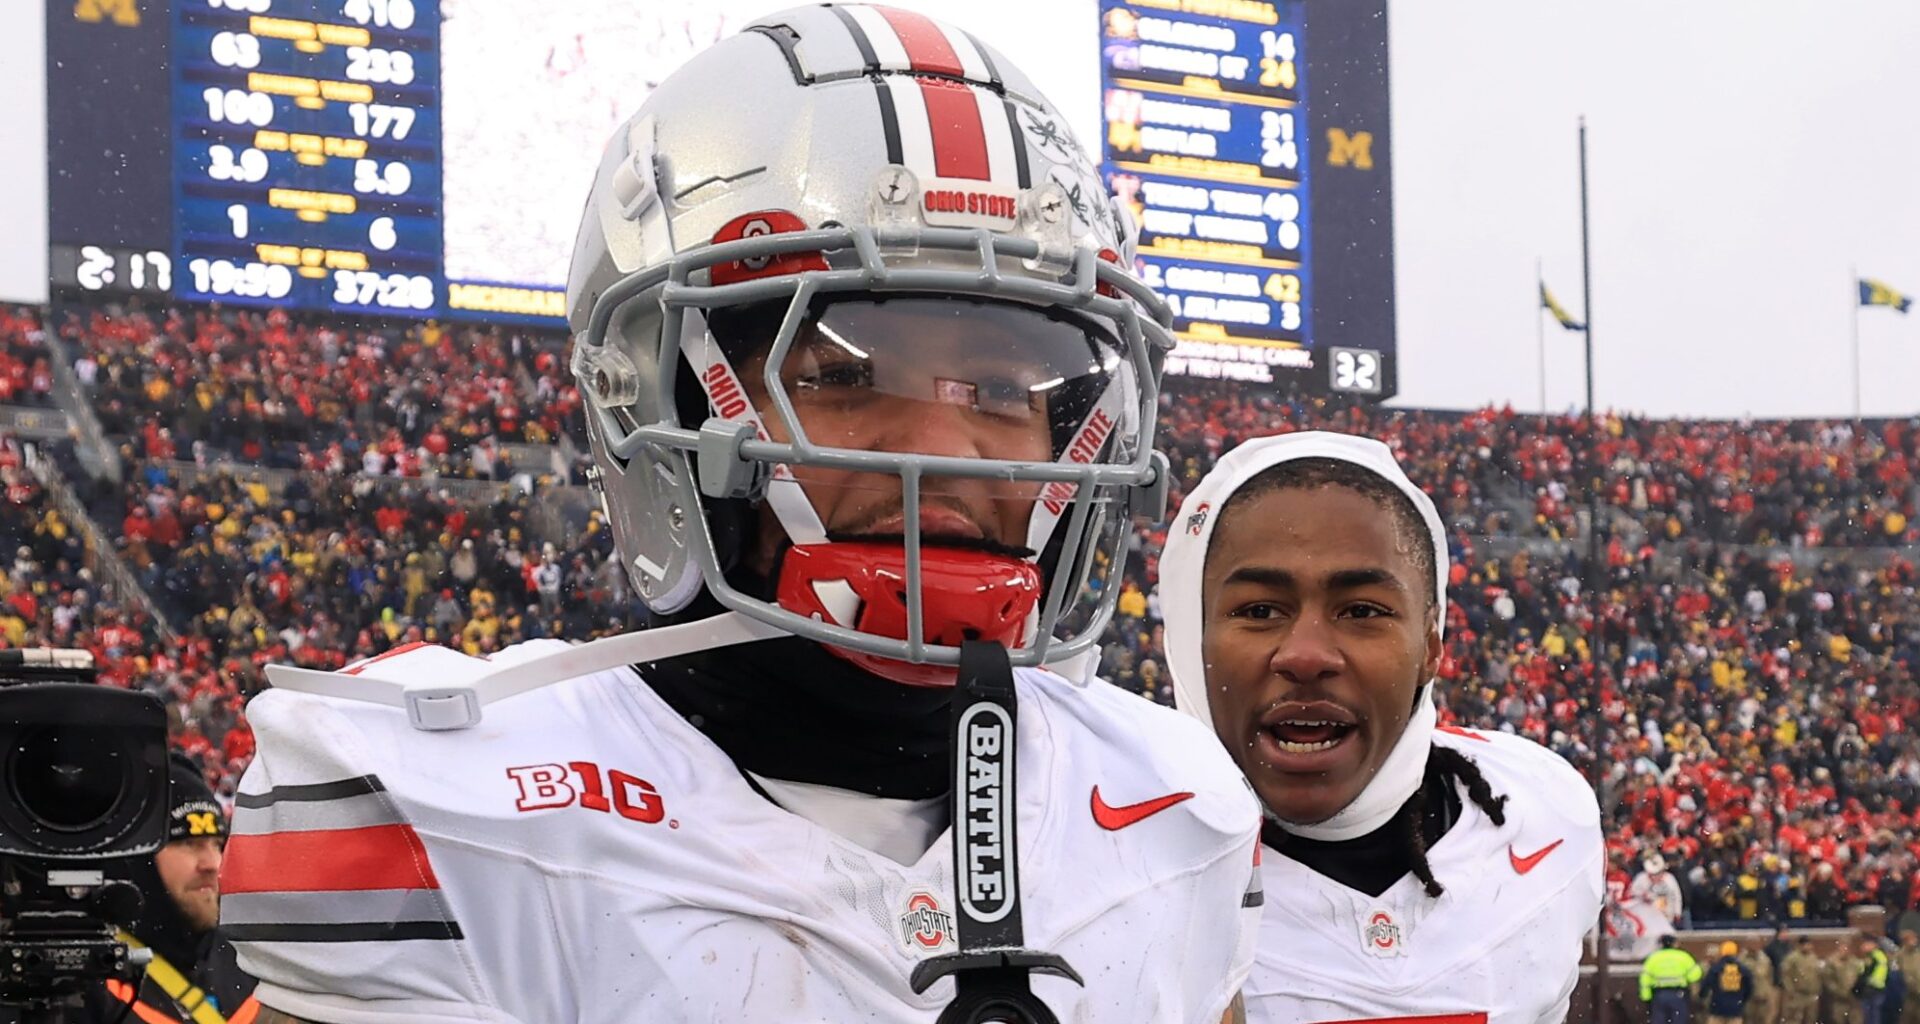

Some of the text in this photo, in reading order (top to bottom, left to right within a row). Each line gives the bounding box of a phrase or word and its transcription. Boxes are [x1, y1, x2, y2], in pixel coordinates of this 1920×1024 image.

[211, 31, 261, 68] 63
[345, 46, 415, 85] 233
[203, 87, 274, 127] 100
[349, 103, 416, 140] 177
[227, 204, 248, 239] 1
[925, 190, 1016, 220] OHIO STATE
[369, 217, 397, 250] 6
[77, 246, 171, 291] 2:17
[1264, 273, 1300, 302] 42
[1281, 302, 1300, 330] 3
[1336, 351, 1376, 390] 32
[702, 363, 747, 419] OHIO
[1069, 408, 1113, 464] STATE
[969, 724, 1003, 901] BATTLE
